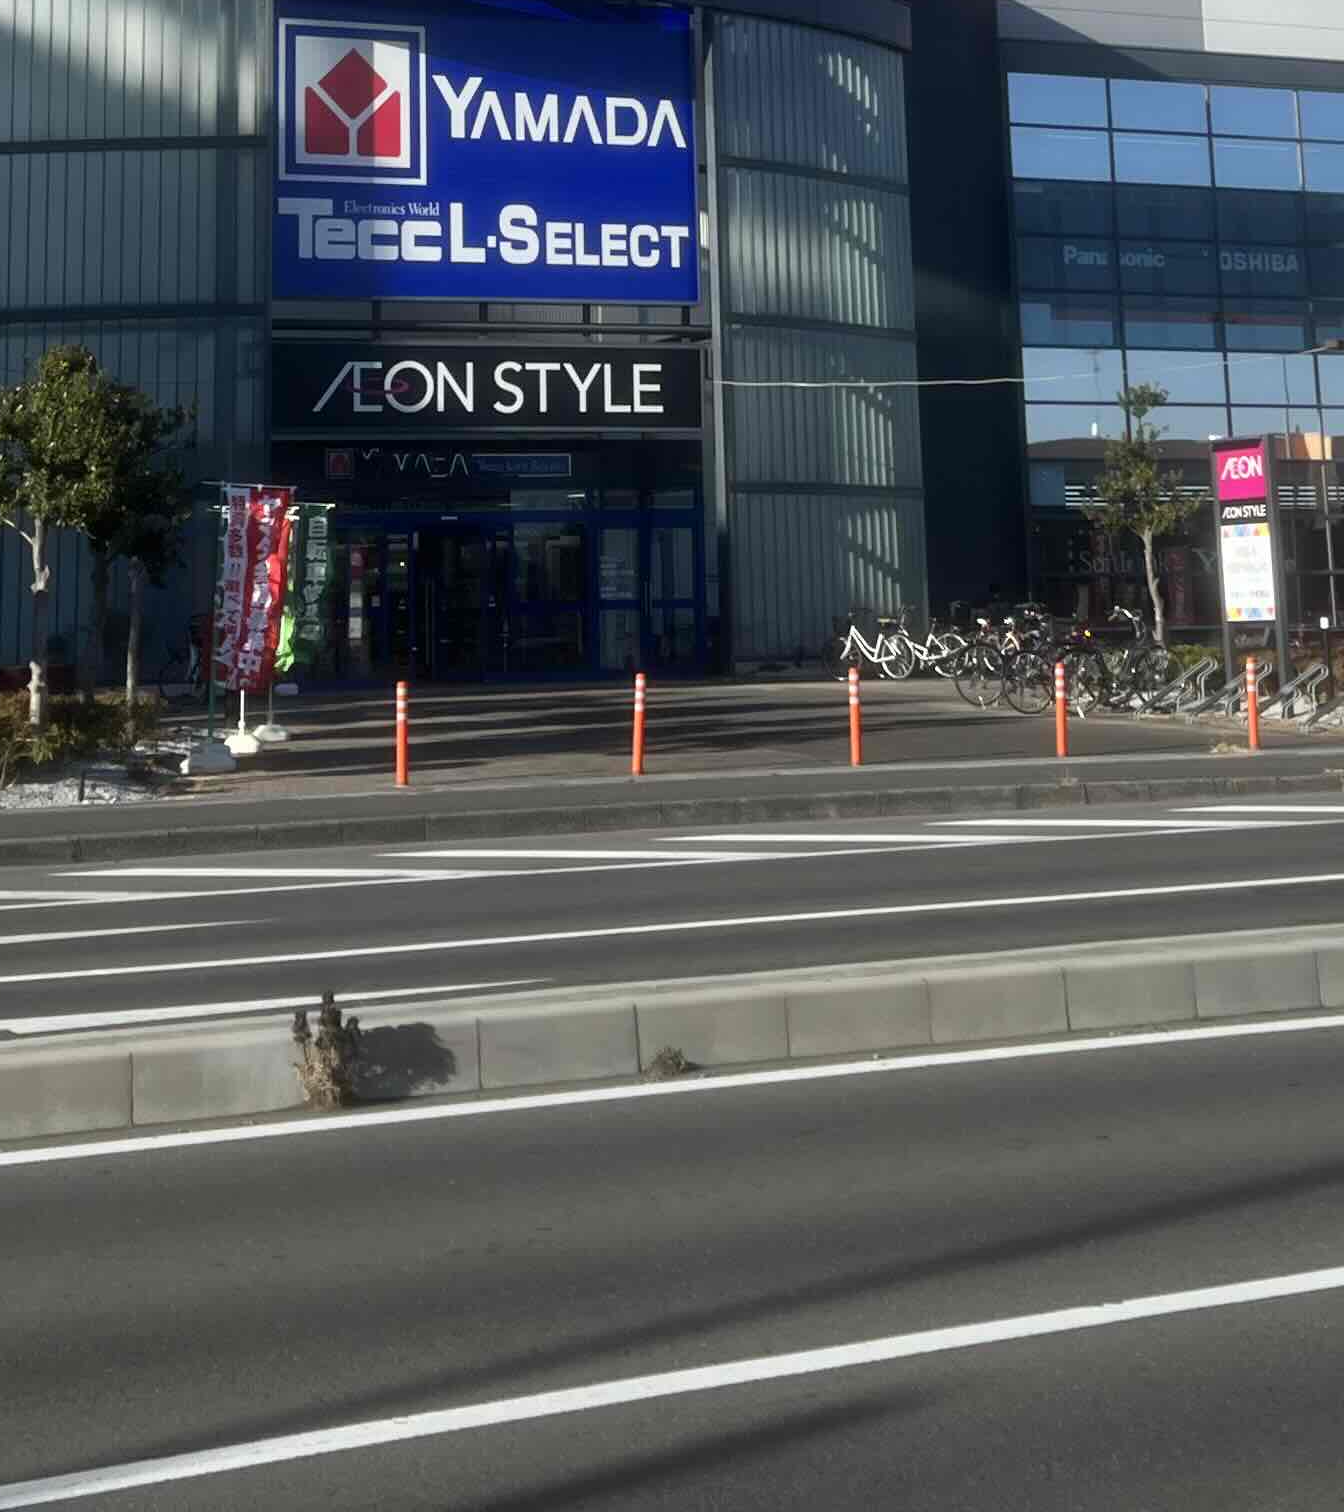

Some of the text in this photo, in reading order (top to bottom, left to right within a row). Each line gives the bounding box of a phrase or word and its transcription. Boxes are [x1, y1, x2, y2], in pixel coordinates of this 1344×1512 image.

[432, 74, 687, 149] YAMADA
[278, 197, 442, 260] Tecc
[344, 200, 440, 218] Electronics World
[1201, 248, 1299, 273] OSHIBA
[492, 361, 665, 415] STYLE
